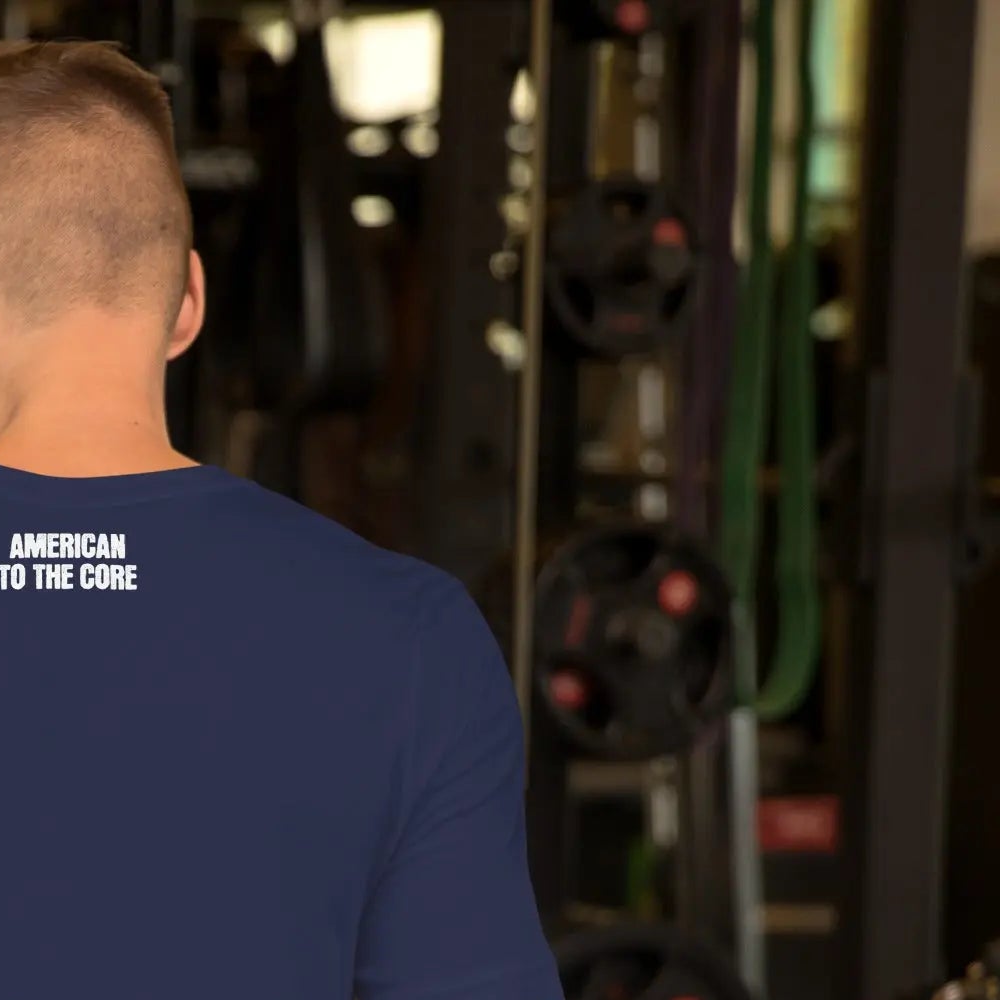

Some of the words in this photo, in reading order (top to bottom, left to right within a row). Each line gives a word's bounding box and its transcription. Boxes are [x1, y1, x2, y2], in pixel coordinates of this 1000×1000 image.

[9, 532, 126, 559] AMERICAN
[32, 563, 74, 590] THE
[79, 563, 138, 590] CORE
